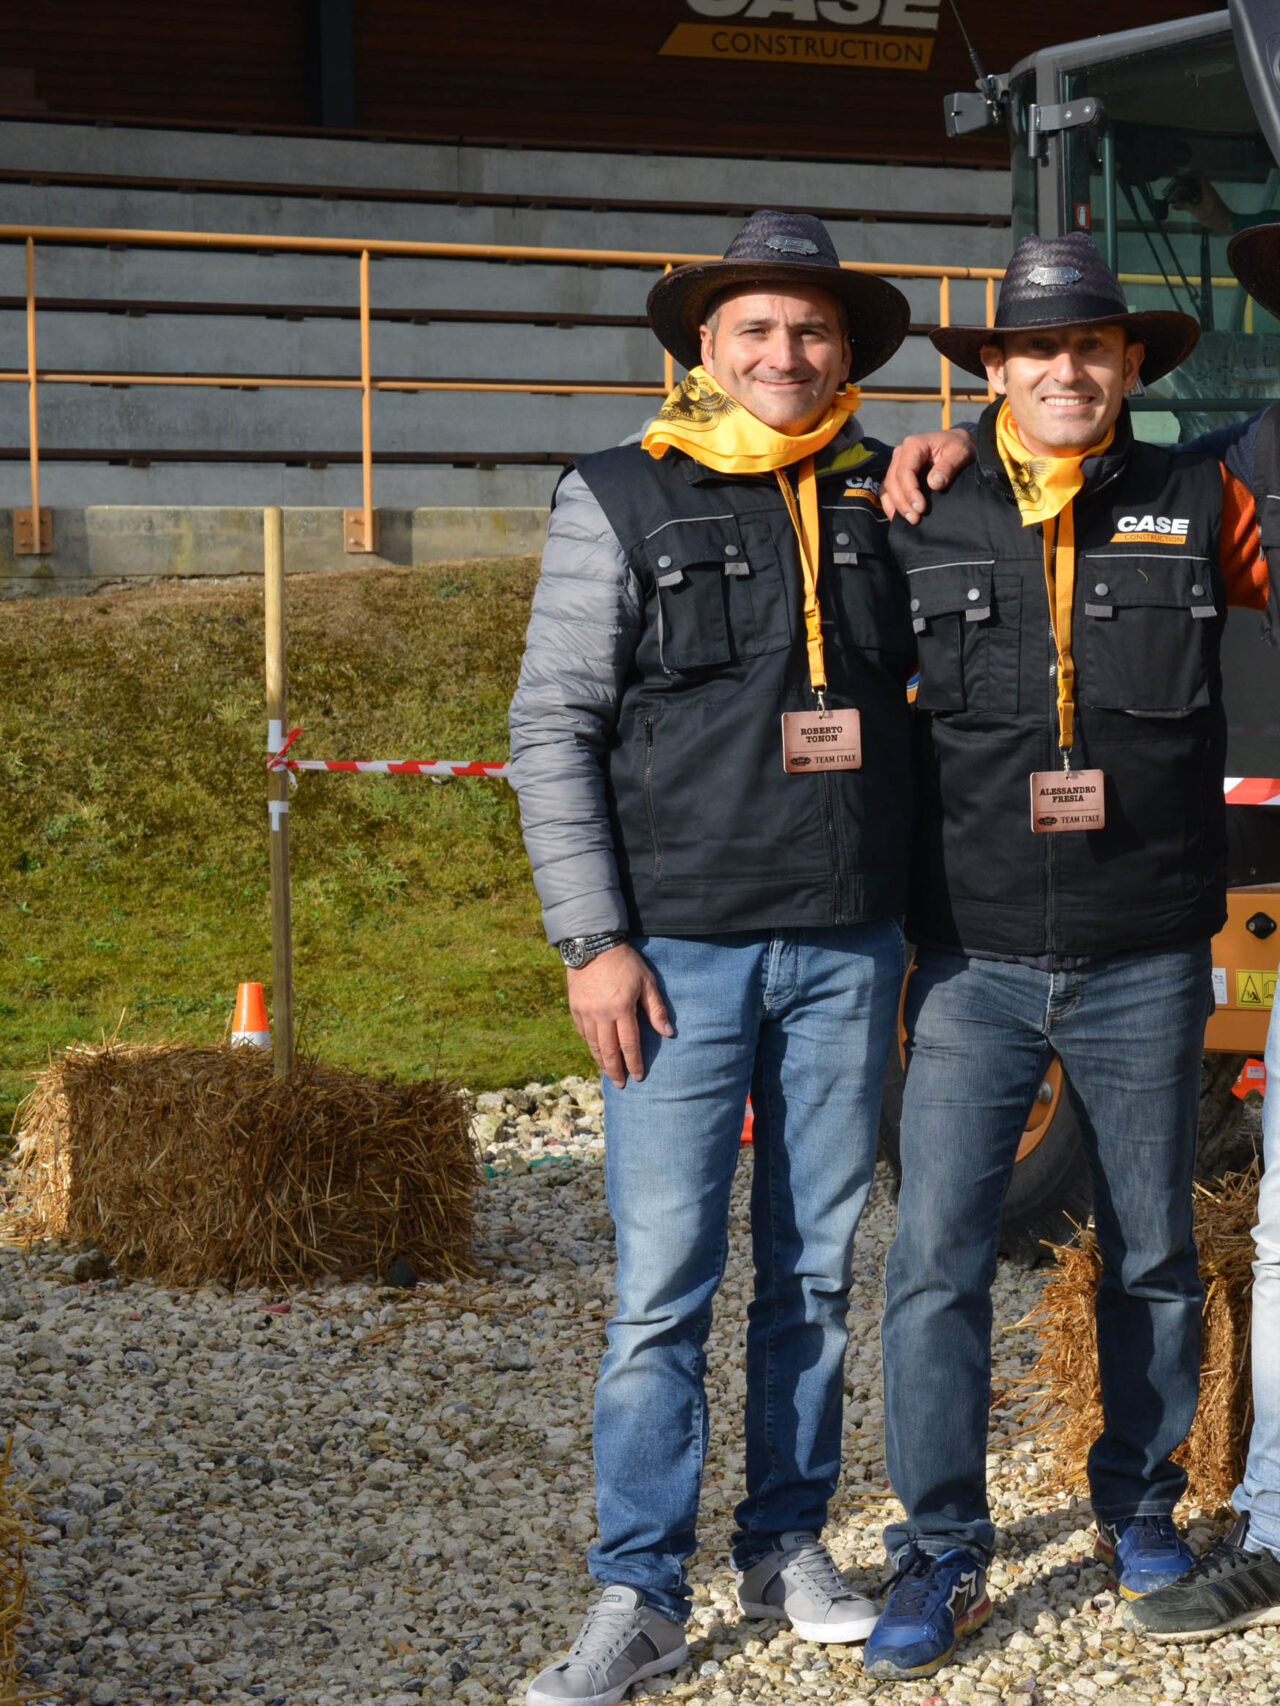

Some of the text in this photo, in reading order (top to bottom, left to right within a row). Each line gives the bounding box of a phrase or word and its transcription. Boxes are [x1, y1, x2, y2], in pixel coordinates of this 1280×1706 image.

[711, 30, 924, 64] CONSTRUCTION
[1117, 515, 1190, 535] CASE
[1124, 534, 1184, 543] CONSTRUCTION
[800, 726, 843, 736] ROBERTO
[806, 734, 838, 743] TONON
[815, 756, 835, 764] TEAM
[837, 754, 856, 763] ITALY
[1040, 786, 1097, 796] ALESSANDRO
[1052, 795, 1085, 803] FRESIA
[1061, 816, 1080, 824] TEAM
[1082, 815, 1100, 823] ITALY
